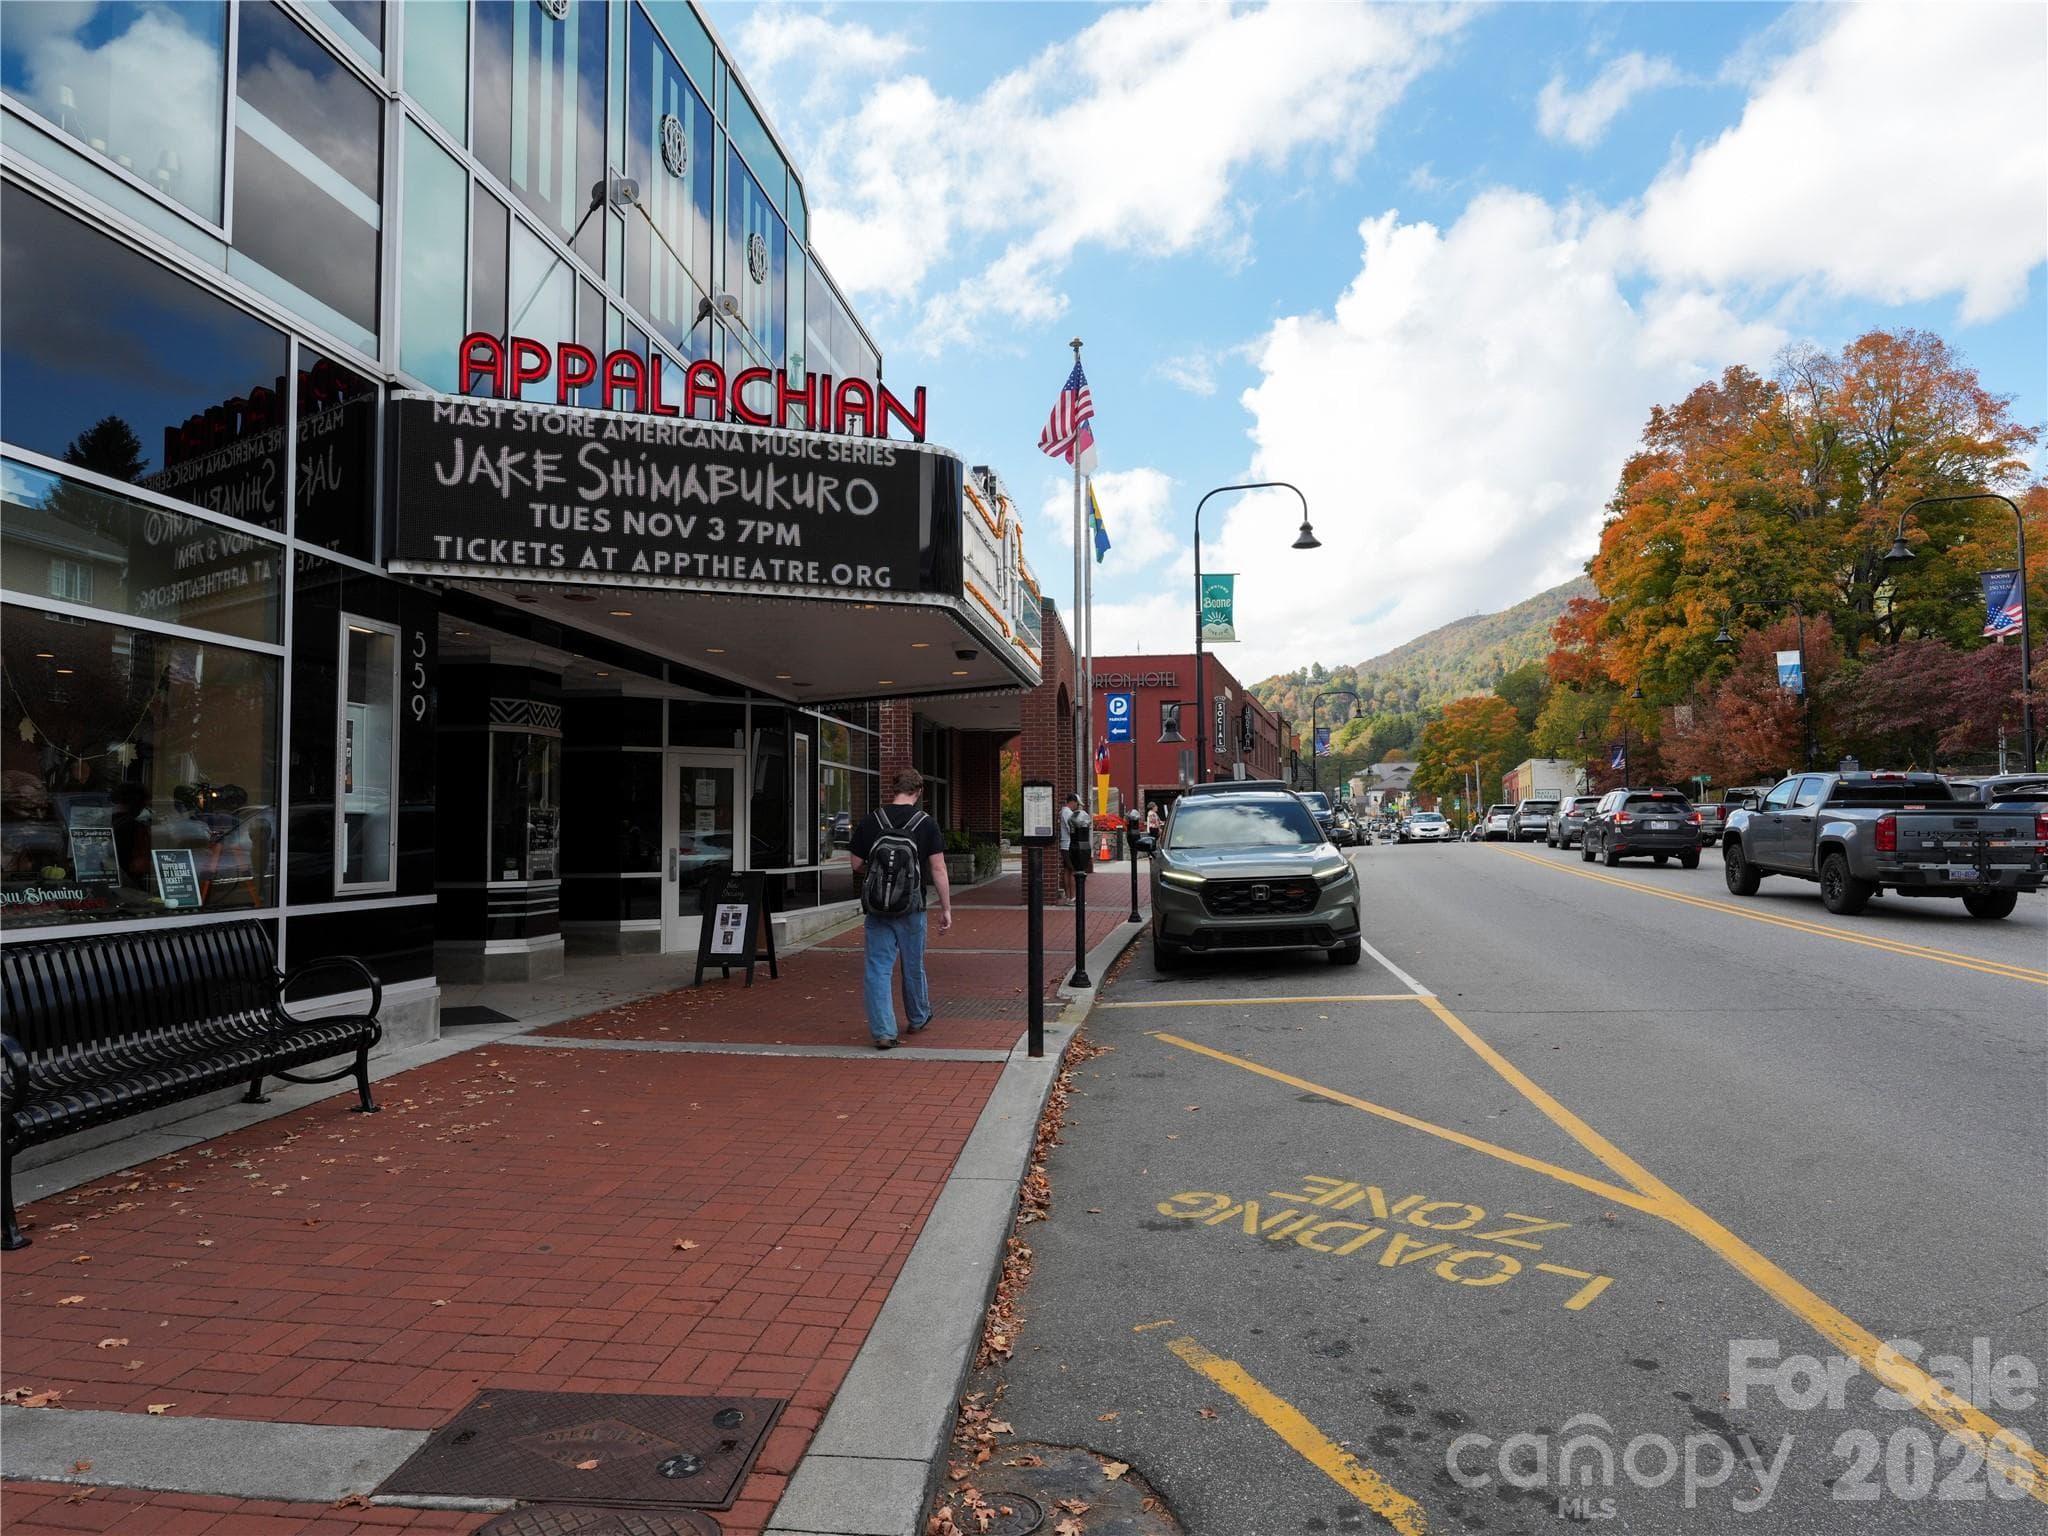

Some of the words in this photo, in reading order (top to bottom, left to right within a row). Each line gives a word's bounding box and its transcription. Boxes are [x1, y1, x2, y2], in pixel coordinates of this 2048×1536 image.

[458, 331, 926, 443] APPALACHIAN
[433, 400, 503, 432] MAST
[513, 408, 596, 440] STORE
[602, 419, 745, 454] AMERICANA
[751, 433, 822, 462] MUSIC
[828, 440, 897, 468] SERIES
[434, 437, 567, 499] JAKE
[529, 503, 611, 533] TUES
[623, 510, 696, 541] NOV
[706, 516, 726, 542] 3
[737, 519, 801, 548] 7PM
[434, 534, 564, 568] TICKETS
[579, 545, 616, 571] AT
[630, 548, 892, 589] APPTHEATRE.ORG
[1203, 597, 1231, 609] Boone
[412, 631, 427, 721] 559
[1137, 671, 1179, 688] HOTEL
[1216, 703, 1224, 745] SOCIAL
[1268, 1175, 1572, 1250] ZONE
[1156, 1191, 1616, 1311] LOADING
